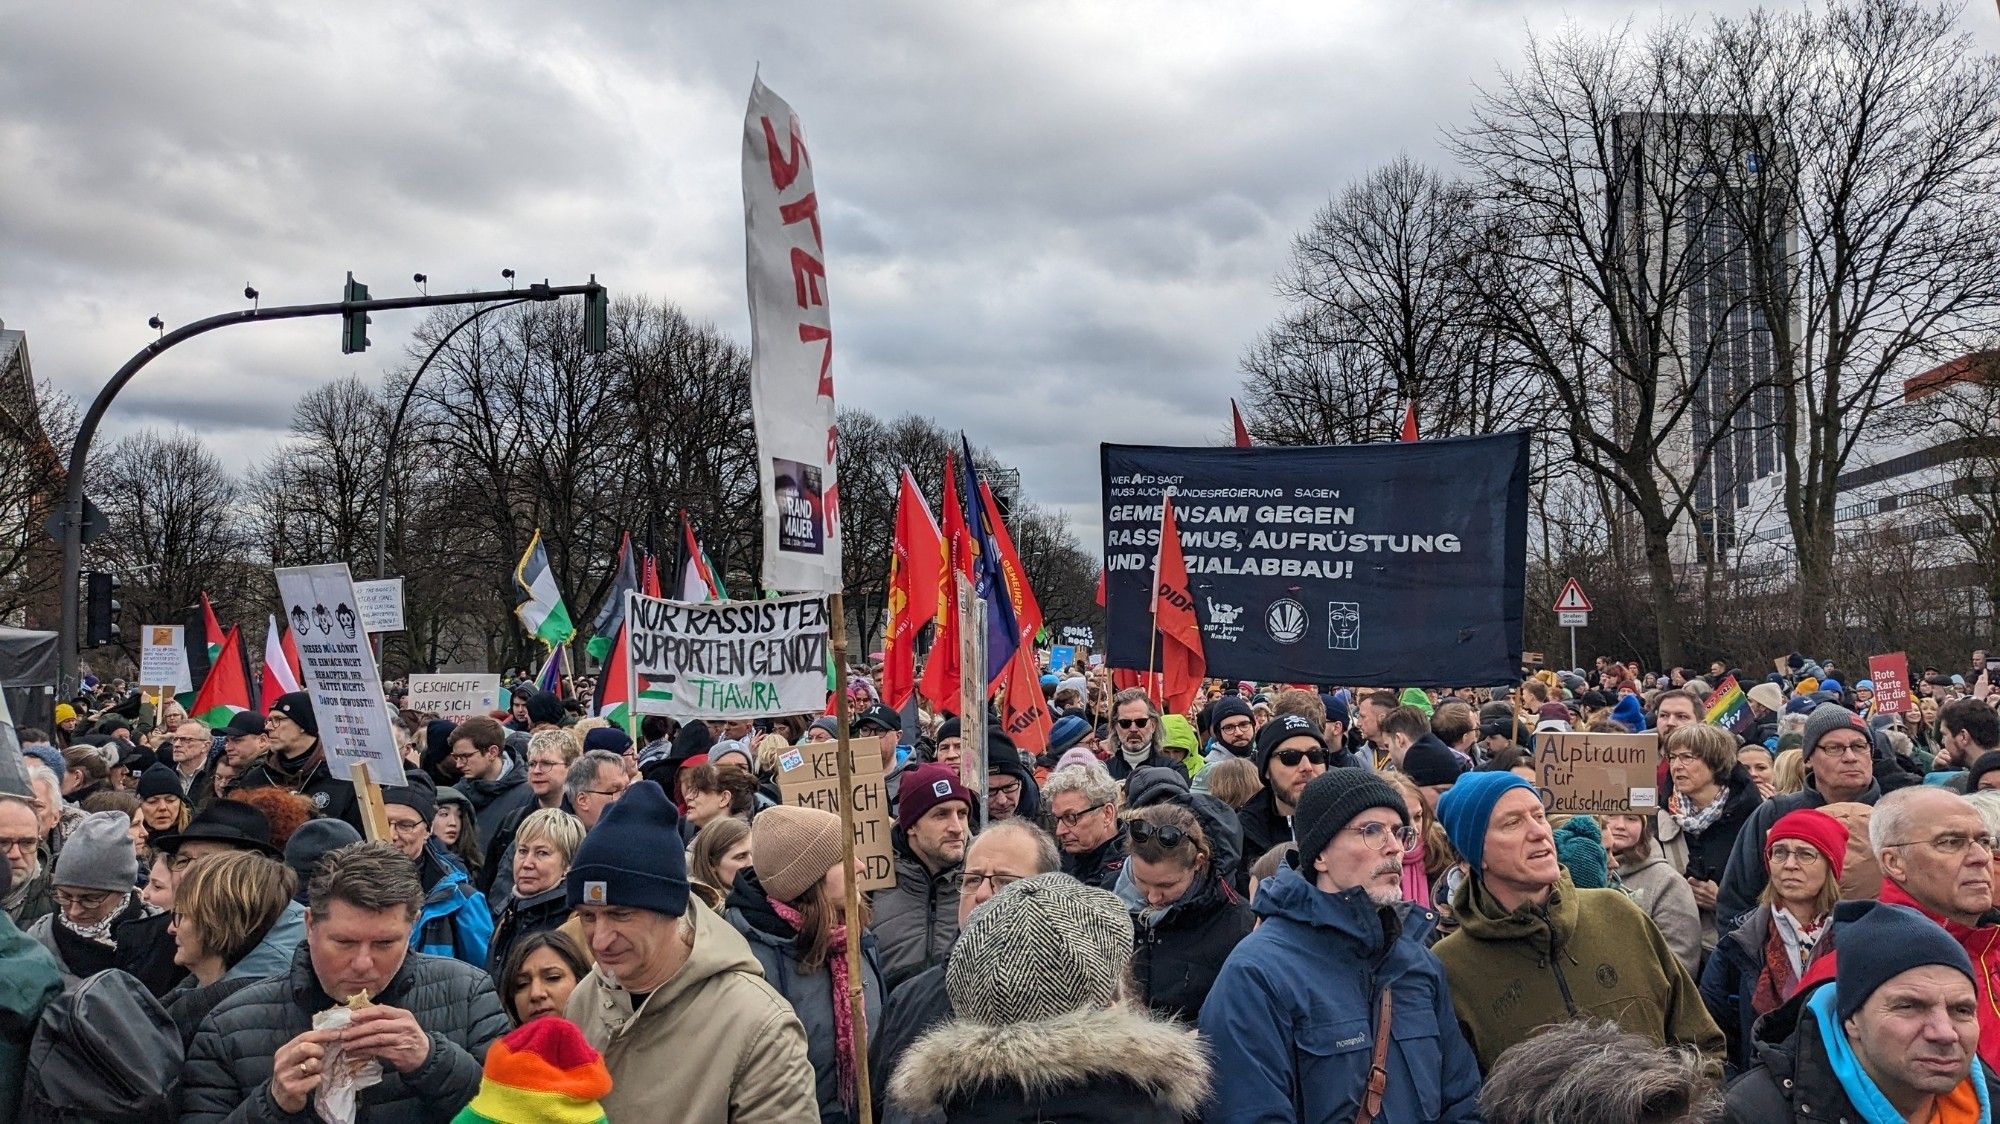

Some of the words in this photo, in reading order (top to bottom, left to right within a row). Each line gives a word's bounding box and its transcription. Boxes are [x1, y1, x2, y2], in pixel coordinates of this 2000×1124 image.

[1110, 476, 1130, 485] WER
[1157, 475, 1184, 485] SAGT
[1110, 487, 1135, 497] MUSS
[1166, 485, 1283, 498] BUNDESREGIERUNG
[1294, 488, 1340, 499] SAGEN
[1255, 505, 1355, 525] GEGEN
[1249, 529, 1461, 554] AUFRÜSTUNG
[1108, 553, 1146, 572] UND
[630, 595, 682, 633] NUR
[684, 598, 829, 636] RASSISTEN
[632, 632, 745, 677] SUPPORTEN
[1873, 670, 1895, 681] Rote
[413, 681, 480, 694] GESCHICHTE
[688, 678, 782, 712] THAWRA
[1875, 680, 1901, 691] Karte
[1877, 690, 1891, 702] für
[1892, 688, 1906, 699] die
[414, 700, 441, 711] DARF
[444, 700, 471, 711] SICH
[1878, 700, 1899, 712] AfD!
[1540, 734, 1646, 773] Alptraum
[1544, 763, 1574, 787] für
[798, 783, 878, 813] MENCH
[1541, 787, 1632, 812] Deutschland
